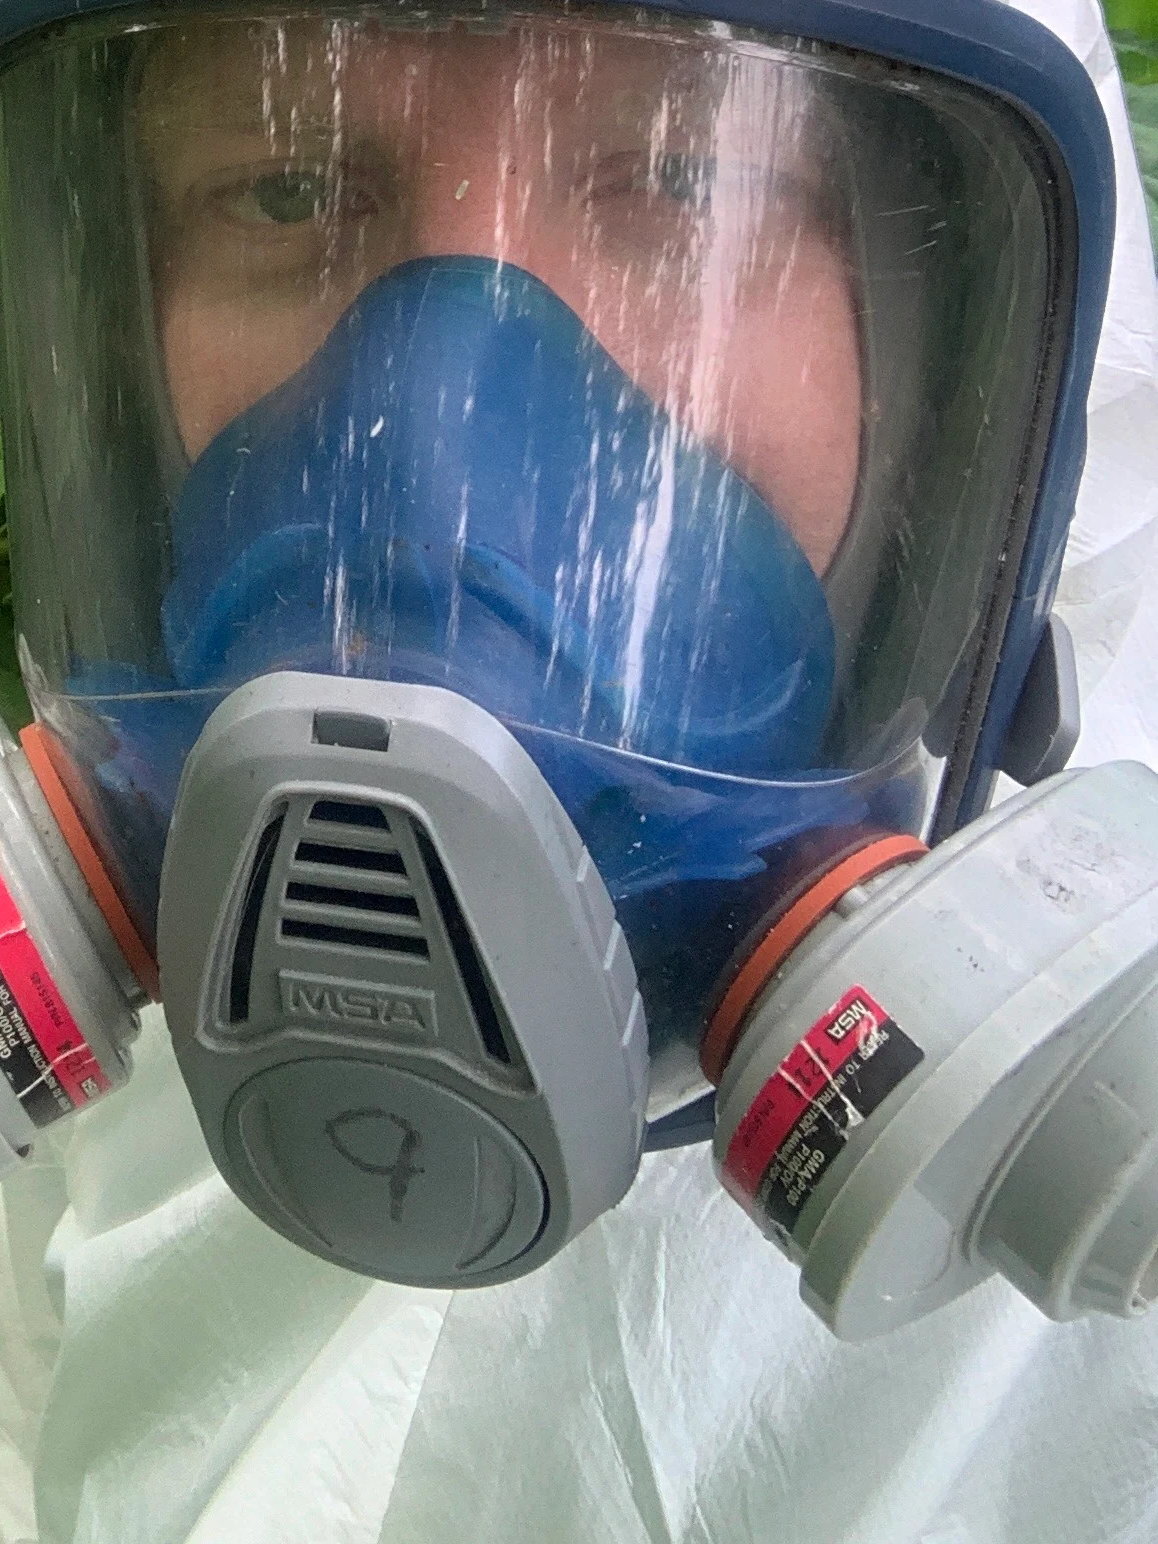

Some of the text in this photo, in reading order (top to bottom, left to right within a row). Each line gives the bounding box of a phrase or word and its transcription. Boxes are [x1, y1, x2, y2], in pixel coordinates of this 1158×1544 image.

[7, 1006, 32, 1043] MANUAL
[289, 982, 427, 1032] MSA
[826, 999, 868, 1040] MSA
[26, 1043, 58, 1089] INSTUCTION
[843, 1059, 860, 1075] TO
